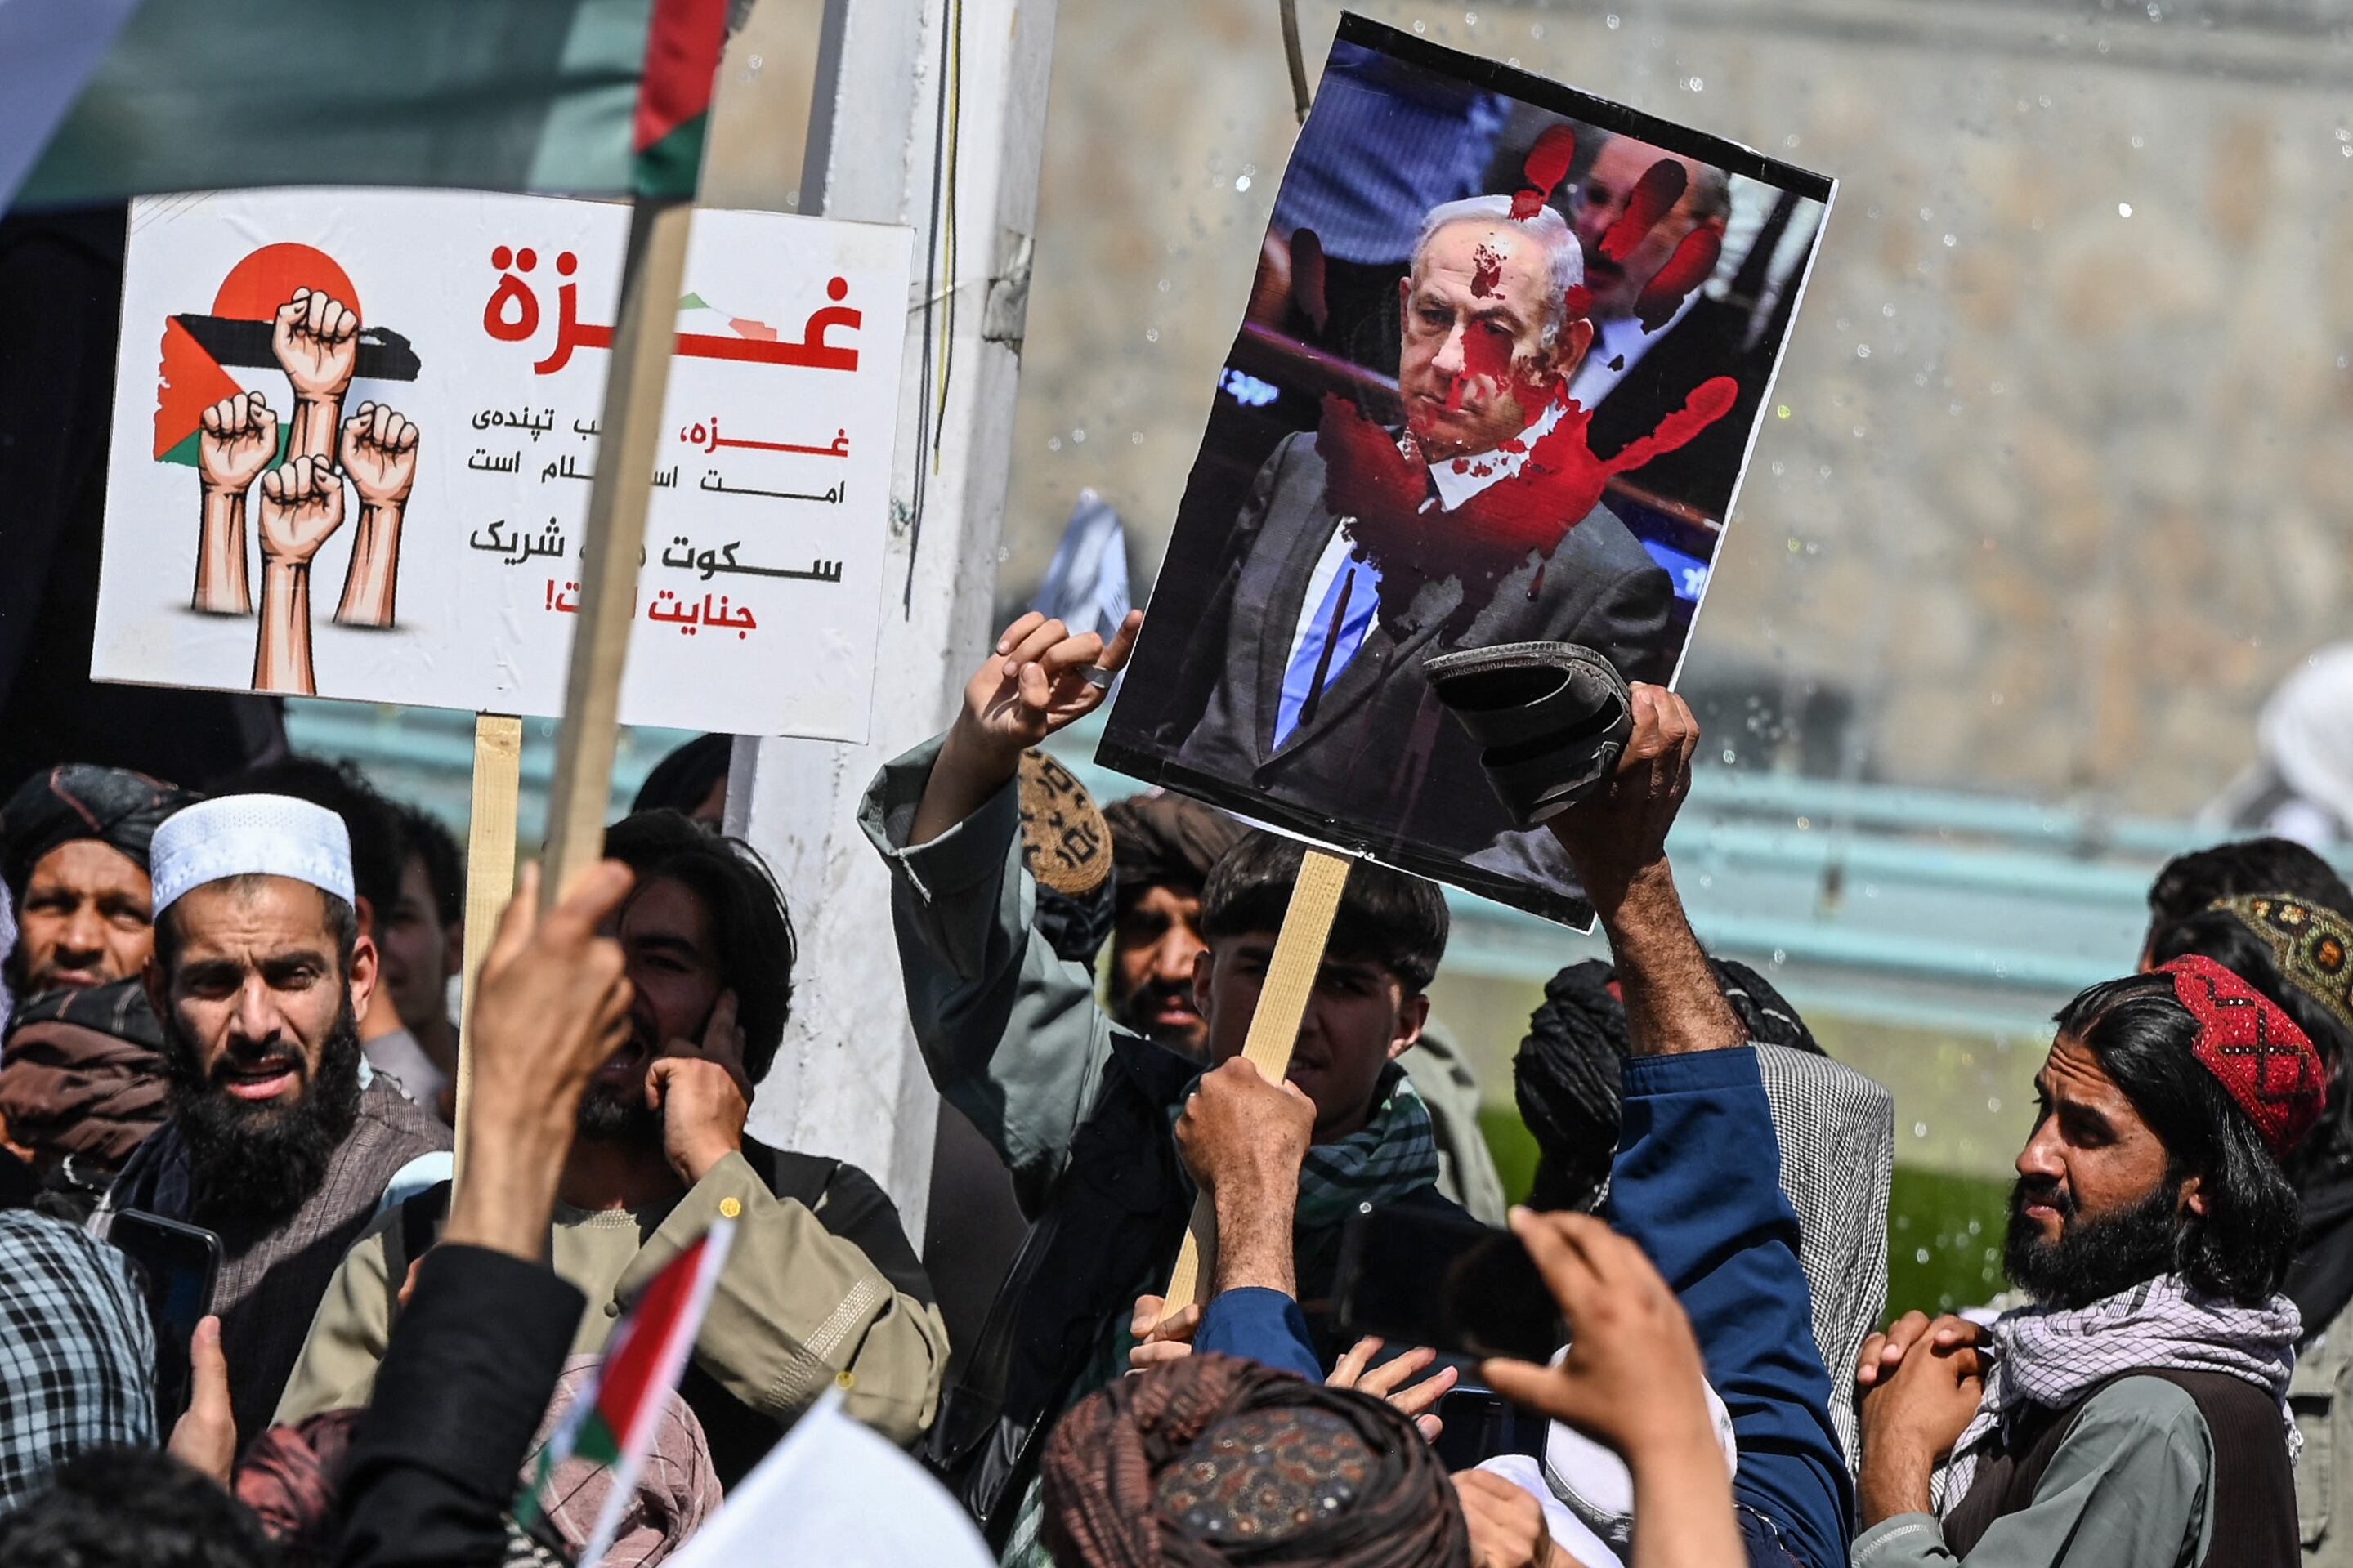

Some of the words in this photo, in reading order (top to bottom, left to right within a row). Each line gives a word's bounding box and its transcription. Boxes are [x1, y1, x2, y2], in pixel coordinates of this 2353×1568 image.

[483, 244, 863, 375] غزة
[467, 448, 521, 475] است
[679, 416, 850, 459] غزه،
[699, 468, 846, 505] امت
[469, 516, 566, 566] شریک
[660, 535, 843, 584] سکوت
[646, 589, 758, 641] جنایت
